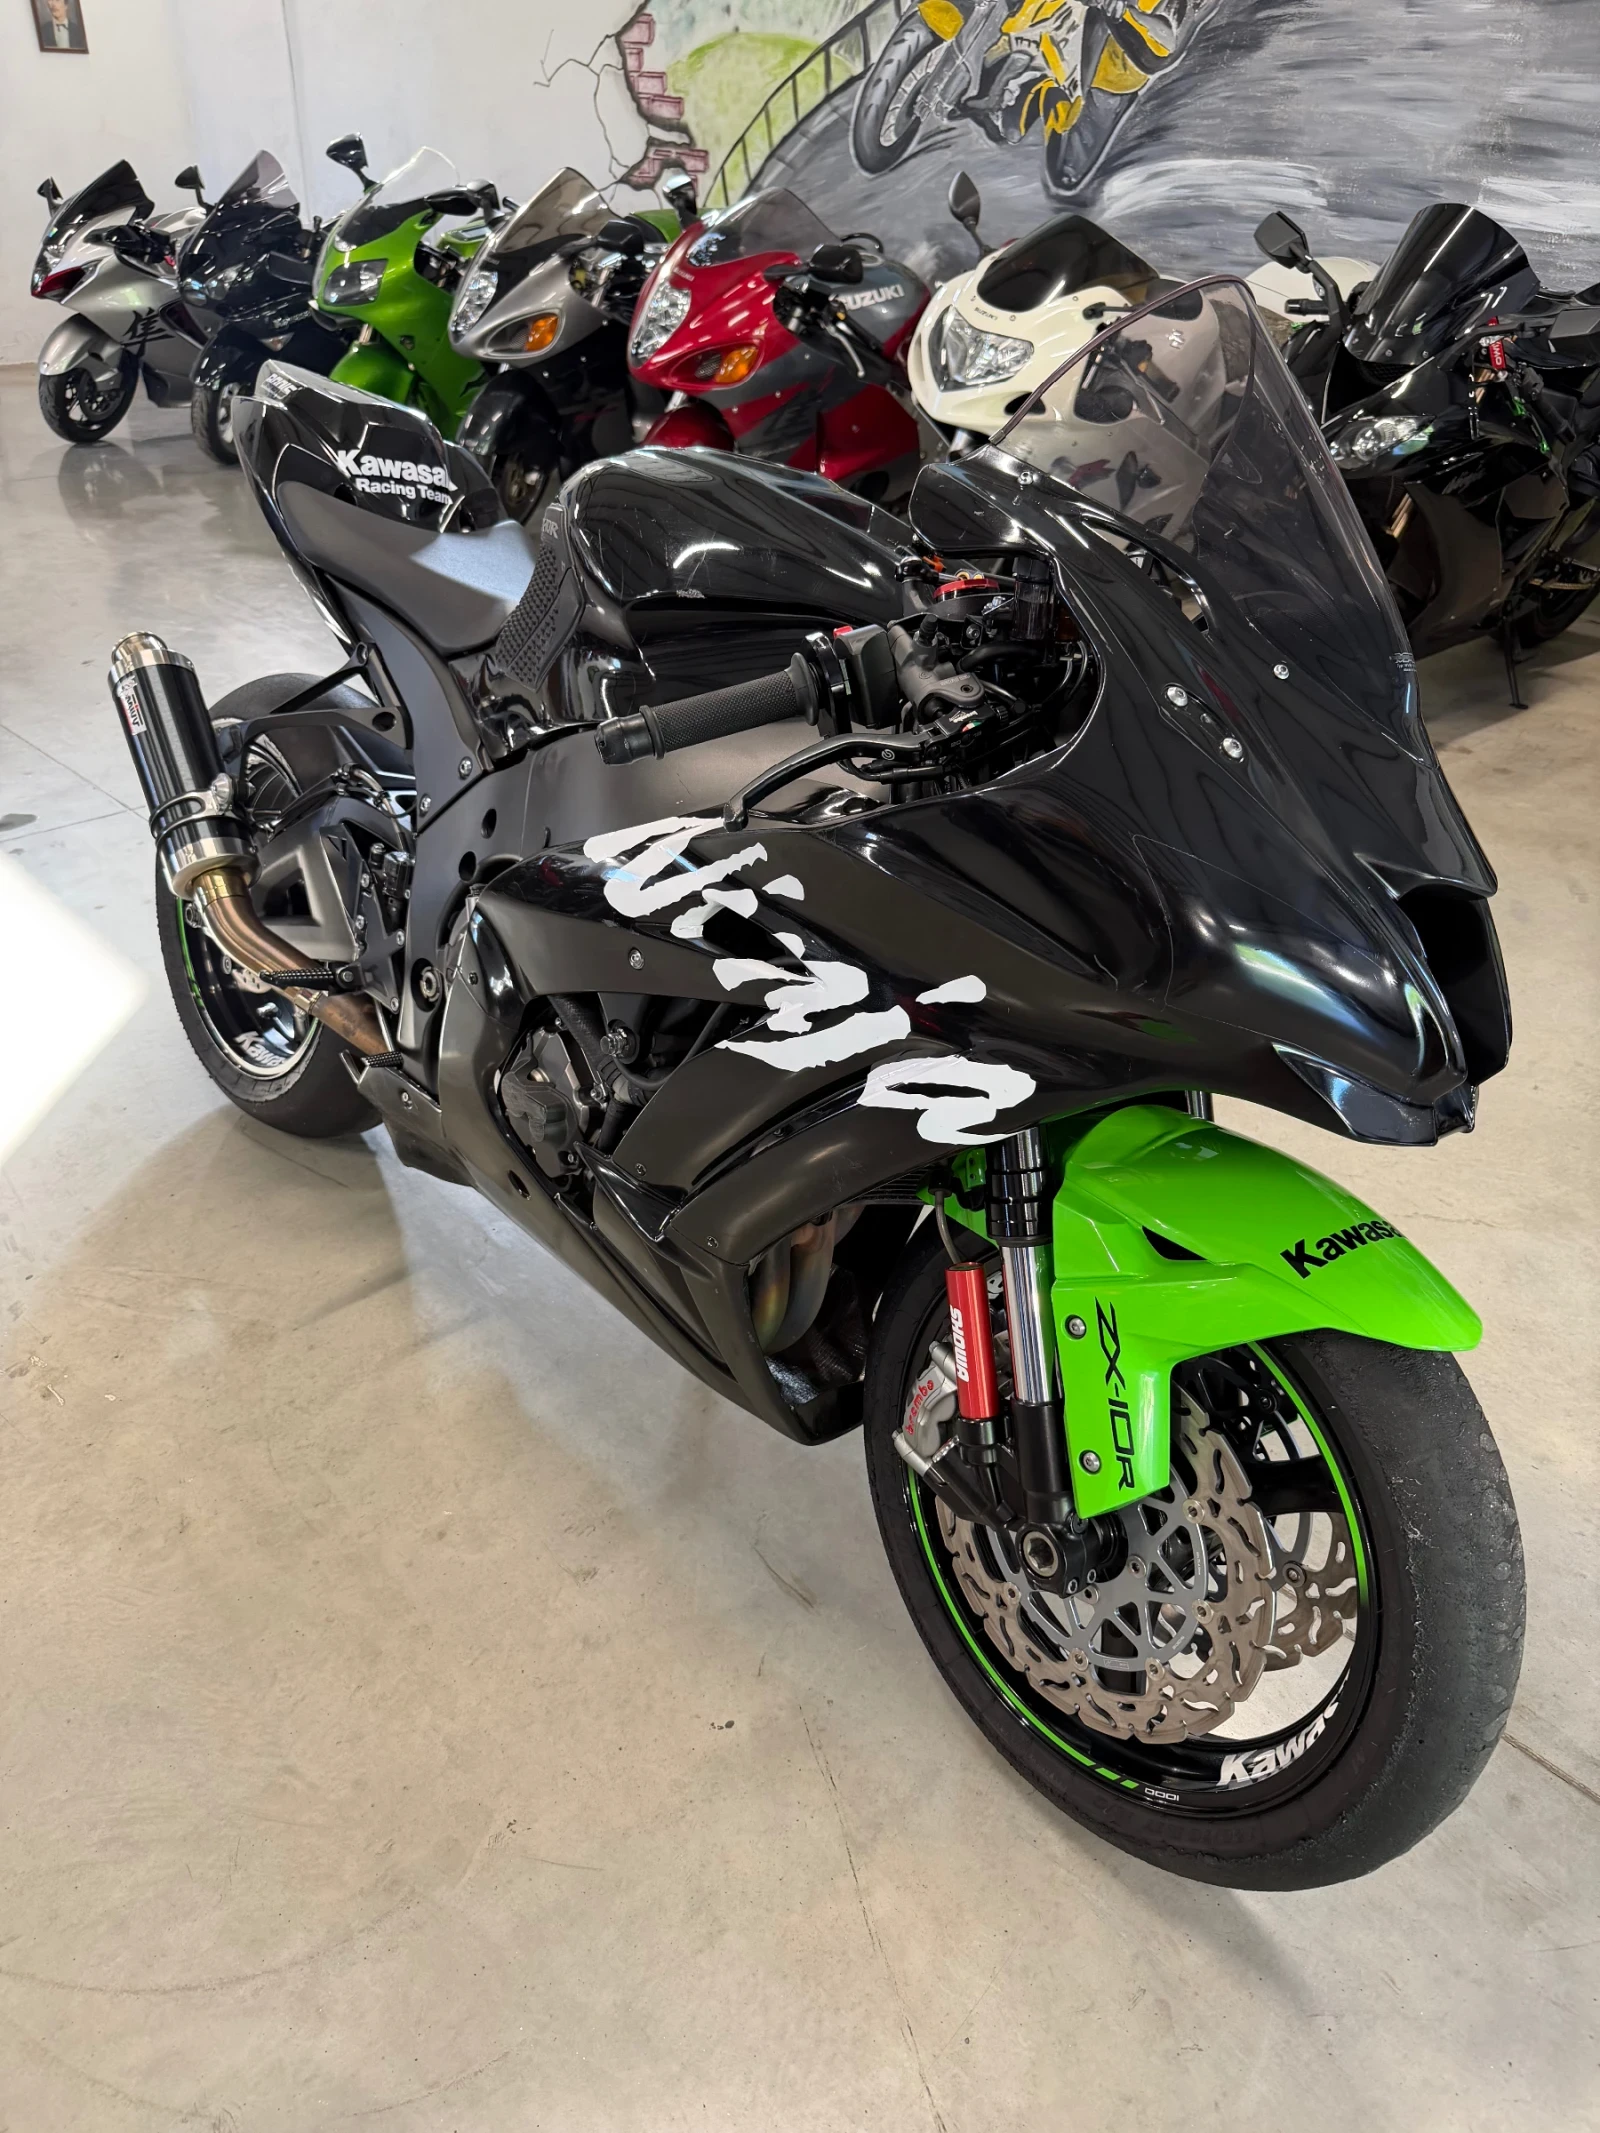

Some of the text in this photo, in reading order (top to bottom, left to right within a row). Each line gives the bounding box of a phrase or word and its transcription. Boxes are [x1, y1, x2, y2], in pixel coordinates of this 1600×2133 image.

[356, 478, 453, 505] Racing Team
[583, 817, 1037, 1146] Ninja
[949, 1304, 970, 1384] SHOWA
[904, 1379, 934, 1436] brembo
[1094, 1296, 1136, 1492] ZX-10R
[1144, 1787, 1180, 1802] 1000
